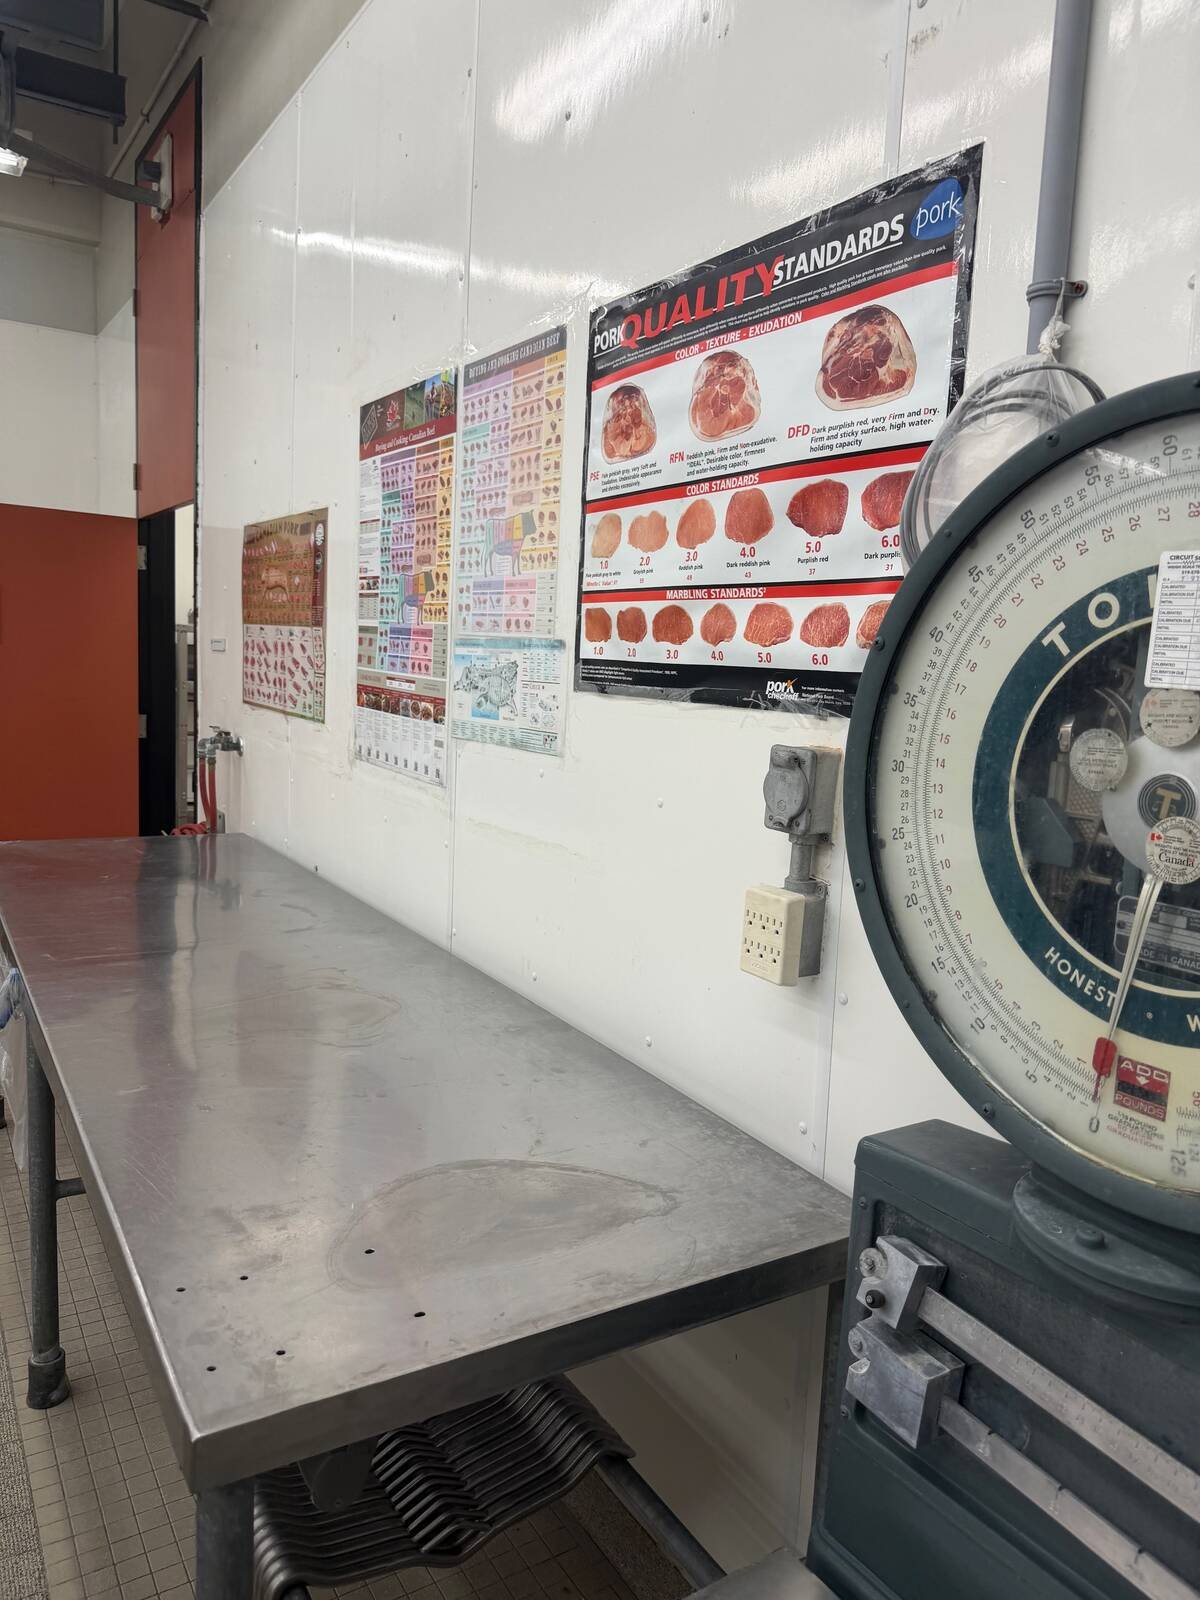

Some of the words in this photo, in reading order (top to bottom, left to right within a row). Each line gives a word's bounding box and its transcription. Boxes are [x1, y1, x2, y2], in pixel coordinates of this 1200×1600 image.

[916, 193, 963, 236] pork
[594, 322, 624, 354] PORK
[620, 255, 785, 349] QUALITY
[773, 214, 905, 285] STANDARDS
[675, 345, 699, 360] COLOR
[706, 331, 741, 350] TEXTURE
[749, 312, 802, 337] EXUDATION
[812, 426, 826, 434] Dark
[828, 420, 854, 434] purplish
[856, 418, 868, 426] red,
[872, 416, 886, 426] very
[888, 412, 905, 421] Firm
[906, 408, 922, 418] and
[923, 407, 940, 416] Dry.
[788, 424, 810, 438] DFD
[826, 432, 838, 441] and
[840, 428, 859, 439] sticky
[860, 424, 888, 436] surface,
[890, 420, 906, 432] high
[908, 417, 934, 428] water-
[686, 452, 703, 460] Reddish
[704, 449, 716, 458] pink,
[717, 446, 728, 454] Firm
[740, 437, 778, 450] Non-exudative.
[810, 442, 834, 453] holding
[835, 438, 863, 450] capacity
[1162, 434, 1178, 456] 60
[670, 452, 684, 464] RFN
[706, 454, 728, 465] Desirable
[730, 452, 743, 460] color,
[744, 447, 766, 458] firmness
[686, 468, 695, 476] and
[696, 464, 728, 476] water-holding
[728, 459, 750, 470] capacity.
[590, 471, 600, 482] PSE
[1085, 466, 1101, 486] 55
[686, 481, 710, 496] COLOR
[712, 473, 760, 491] STANDARDS
[1020, 509, 1036, 530] 50
[1158, 506, 1170, 522] 27
[1129, 515, 1141, 532] 26
[882, 534, 900, 548] 6.0
[1102, 526, 1114, 543] 25
[740, 546, 756, 558] 4.0
[806, 541, 822, 553] 5.0
[1076, 540, 1089, 556] 24
[640, 556, 650, 566] 2.0
[686, 551, 698, 562] 3.0
[600, 560, 608, 570] 1.0
[758, 560, 770, 568] pink
[1052, 556, 1066, 572] 23
[968, 565, 984, 583] 45
[1030, 574, 1044, 590] 22
[666, 588, 708, 600] MARBLING
[1012, 592, 1024, 607] 21
[994, 614, 1006, 628] 20
[929, 626, 944, 643] 40
[594, 647, 604, 656] 1.0
[628, 648, 636, 658] 2.0
[666, 650, 679, 660] 3.0
[711, 650, 724, 661] 4.0
[758, 652, 772, 663] 5.0
[812, 654, 828, 665] 6.0
[966, 660, 978, 672] 18
[766, 680, 796, 694] pork
[956, 683, 967, 696] 17
[767, 691, 799, 700] checkoff
[904, 692, 918, 707] 35
[946, 708, 957, 720] 16
[940, 732, 951, 744] 15
[892, 760, 905, 772] 30
[936, 758, 946, 768] 14
[932, 784, 943, 794] 13
[1154, 787, 1182, 820] T
[901, 816, 910, 824] 26
[932, 809, 944, 819] 12
[892, 827, 905, 840] 25
[906, 854, 914, 863] 23
[940, 858, 950, 870] 10
[1158, 852, 1194, 868] Canada
[908, 868, 917, 876] 22
[912, 880, 920, 890] 21
[904, 894, 918, 908] 20
[932, 957, 946, 974] 15
[994, 978, 1004, 990] 5
[1044, 947, 1116, 1008] HONEST
[970, 1017, 986, 1034] 10
[1026, 1070, 1038, 1084] 5
[1121, 1060, 1168, 1083] ADD
[1115, 1093, 1164, 1119] POUNDS
[1088, 1117, 1100, 1133] 0
[1171, 1149, 1186, 1176] 125
